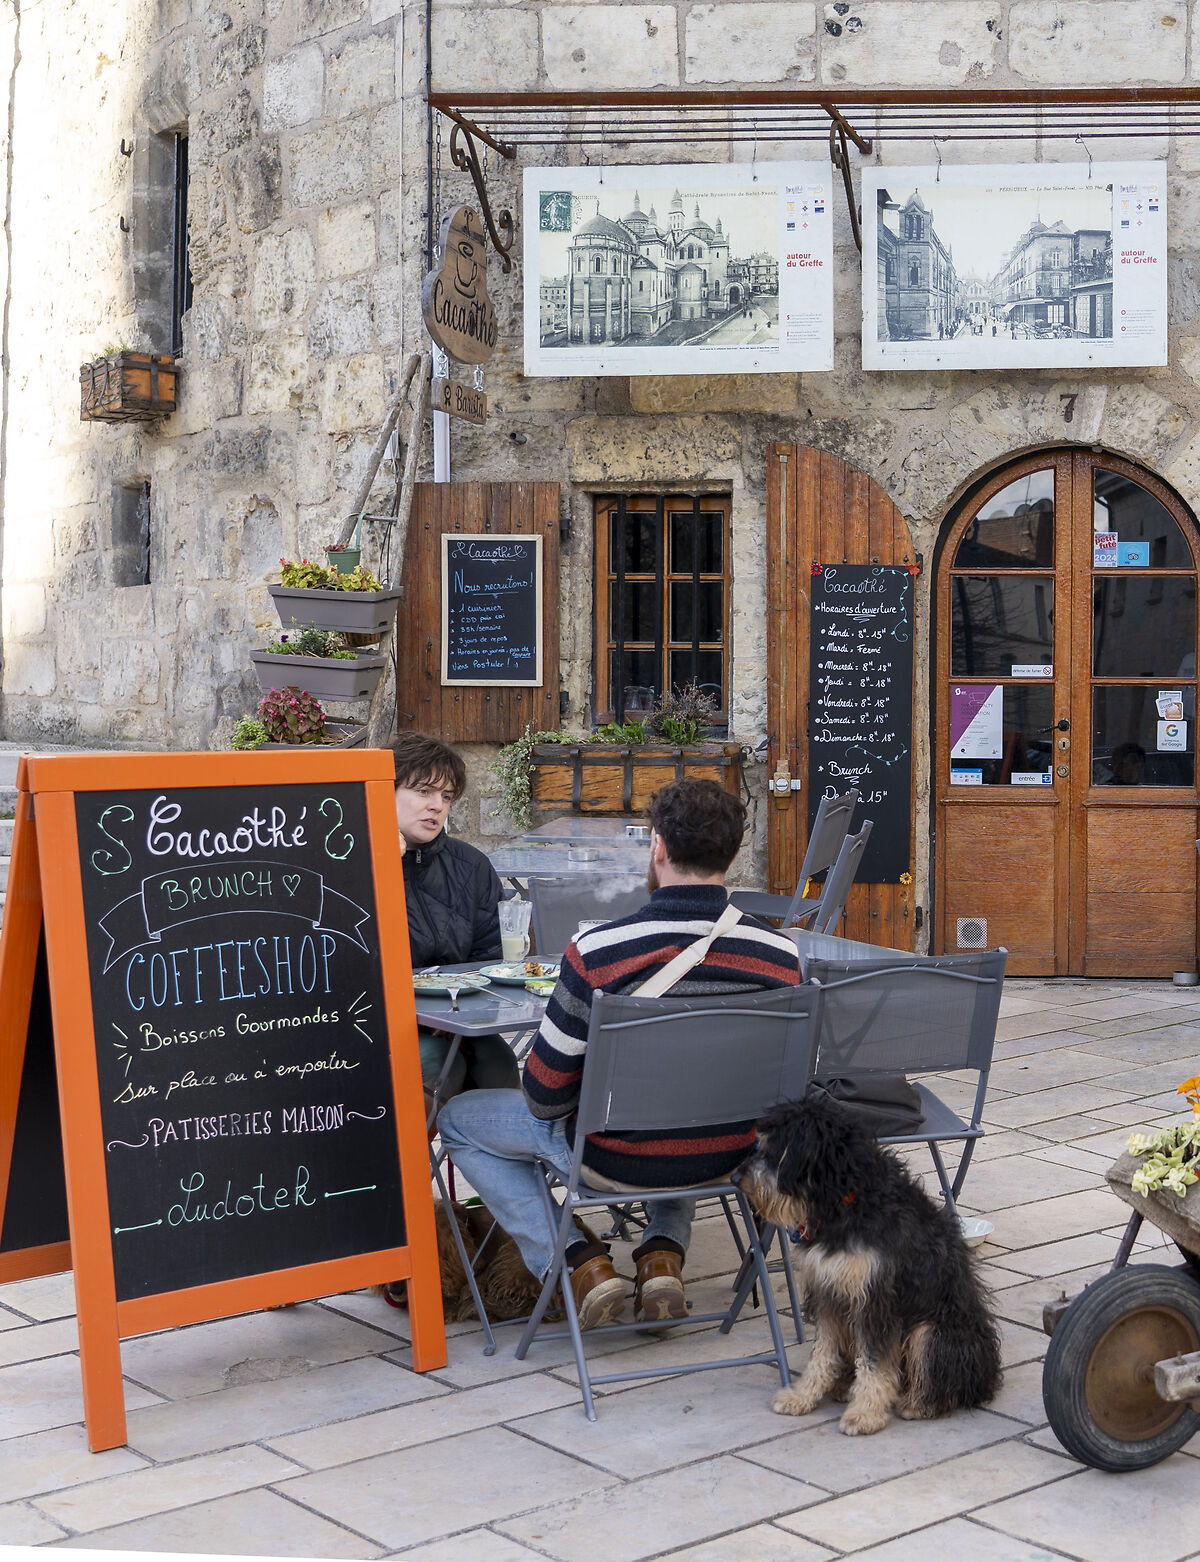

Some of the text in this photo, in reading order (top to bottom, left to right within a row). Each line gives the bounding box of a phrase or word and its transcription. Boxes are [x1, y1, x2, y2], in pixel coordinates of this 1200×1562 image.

[799, 259, 824, 268] Greffe
[1133, 256, 1158, 264] Greffe
[434, 279, 496, 348] Cacaothé
[455, 385, 484, 420] Barista
[1060, 393, 1078, 423] 7
[468, 542, 512, 558] Cacaothé
[1095, 534, 1116, 546] petit
[454, 568, 481, 593] Nous
[824, 568, 887, 593] Cacaothé
[459, 603, 464, 612] 1
[821, 601, 897, 614] Horaires d'ouverture
[856, 644, 881, 654] Fermé
[828, 761, 872, 776] Brunch
[858, 791, 865, 802] à
[146, 795, 309, 858] Cacaothé
[160, 870, 273, 910] BRUNCH
[126, 934, 338, 1012] COFFEESHOP
[140, 1009, 340, 1052] Boissons Gourmandes
[114, 1082, 158, 1104] sur
[166, 1070, 218, 1100] place
[224, 1070, 247, 1084] ou
[275, 1056, 360, 1084] emporter
[148, 1104, 345, 1148] PATISSERIES MAISON
[168, 1164, 317, 1227] Ludotek
